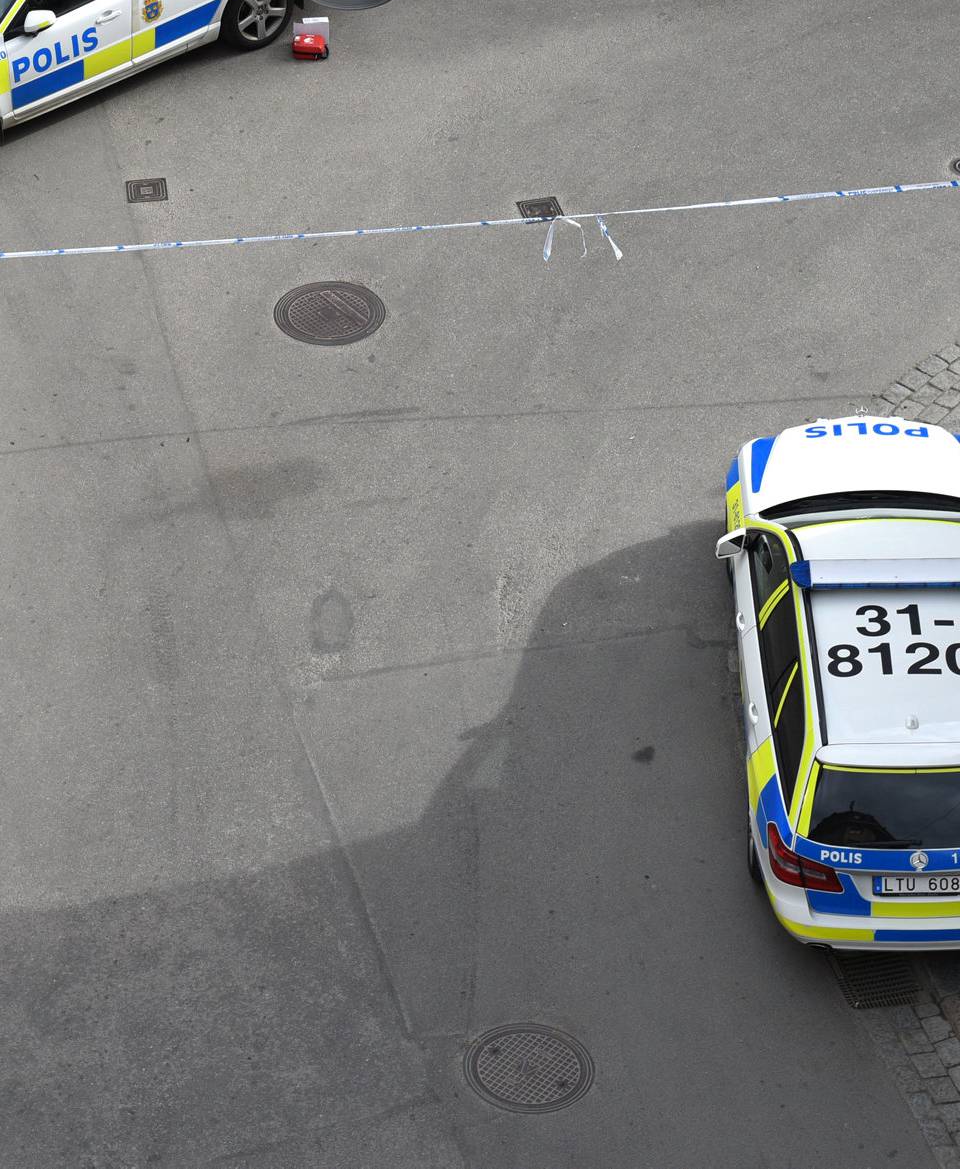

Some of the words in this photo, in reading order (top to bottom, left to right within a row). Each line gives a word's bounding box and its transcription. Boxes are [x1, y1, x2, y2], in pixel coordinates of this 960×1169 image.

[12, 26, 99, 83] POLIS
[805, 422, 929, 438] POLIS
[856, 604, 955, 637] 31-
[820, 849, 863, 864] POLIS
[884, 878, 916, 892] LTU
[928, 877, 960, 891] 608
